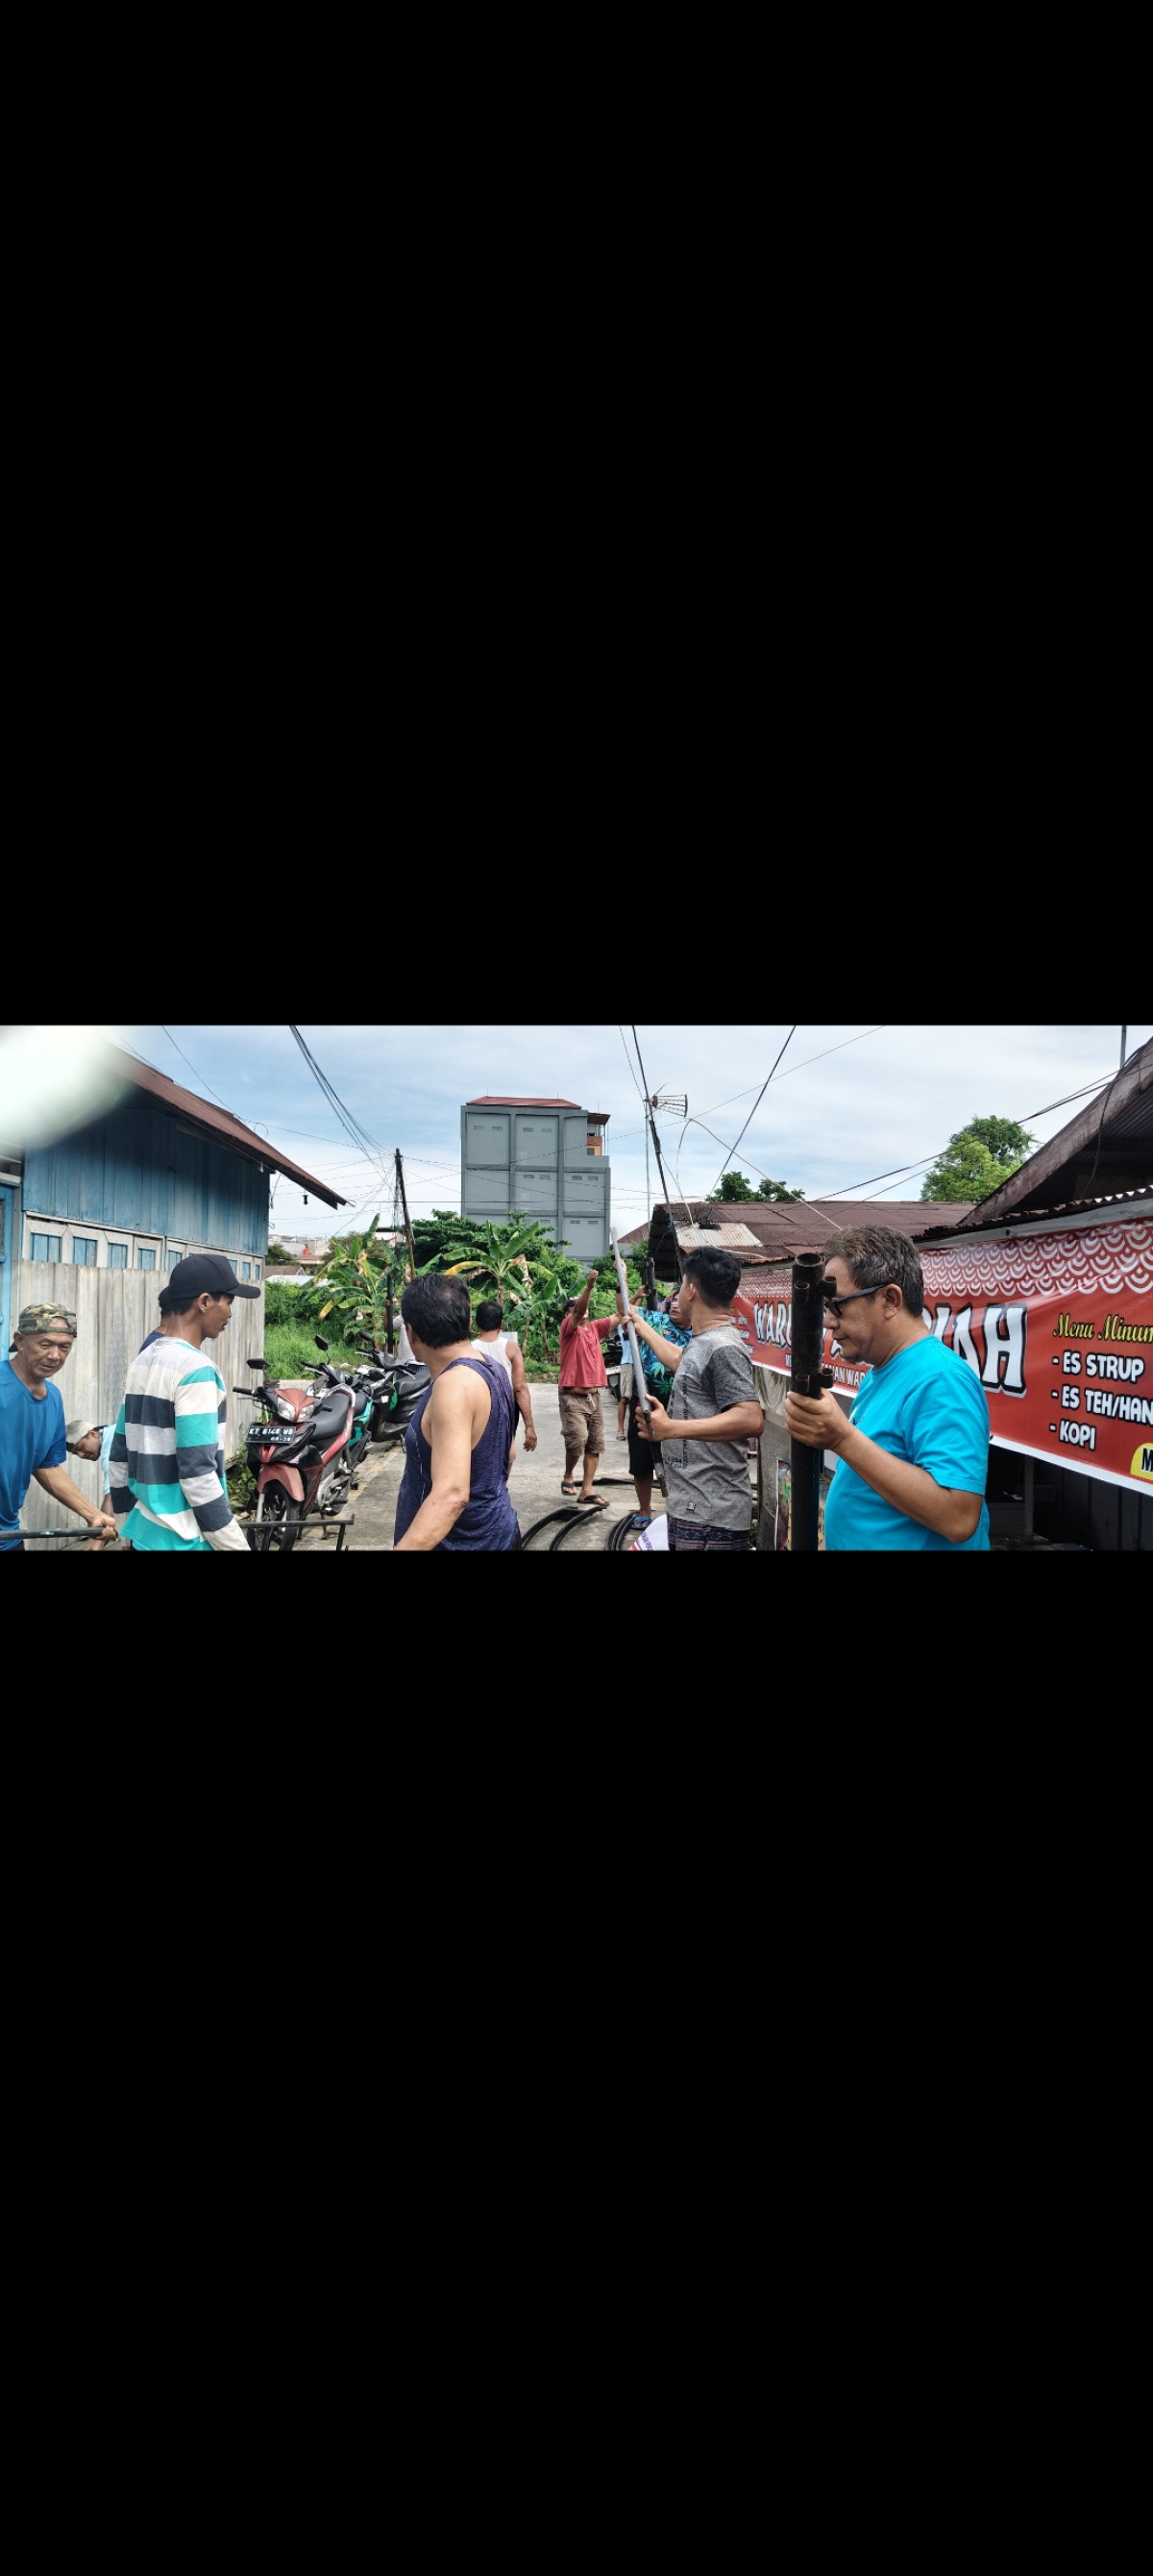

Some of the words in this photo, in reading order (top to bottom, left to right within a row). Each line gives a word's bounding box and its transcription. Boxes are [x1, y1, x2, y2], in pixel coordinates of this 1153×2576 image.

[1053, 1313, 1094, 1338] Menu
[1063, 1350, 1081, 1375] ES
[1086, 1353, 1144, 1382] STRUP
[1062, 1385, 1080, 1408] ES
[1085, 1389, 1153, 1424] TEH/HAN
[1060, 1421, 1095, 1450] KOPI
